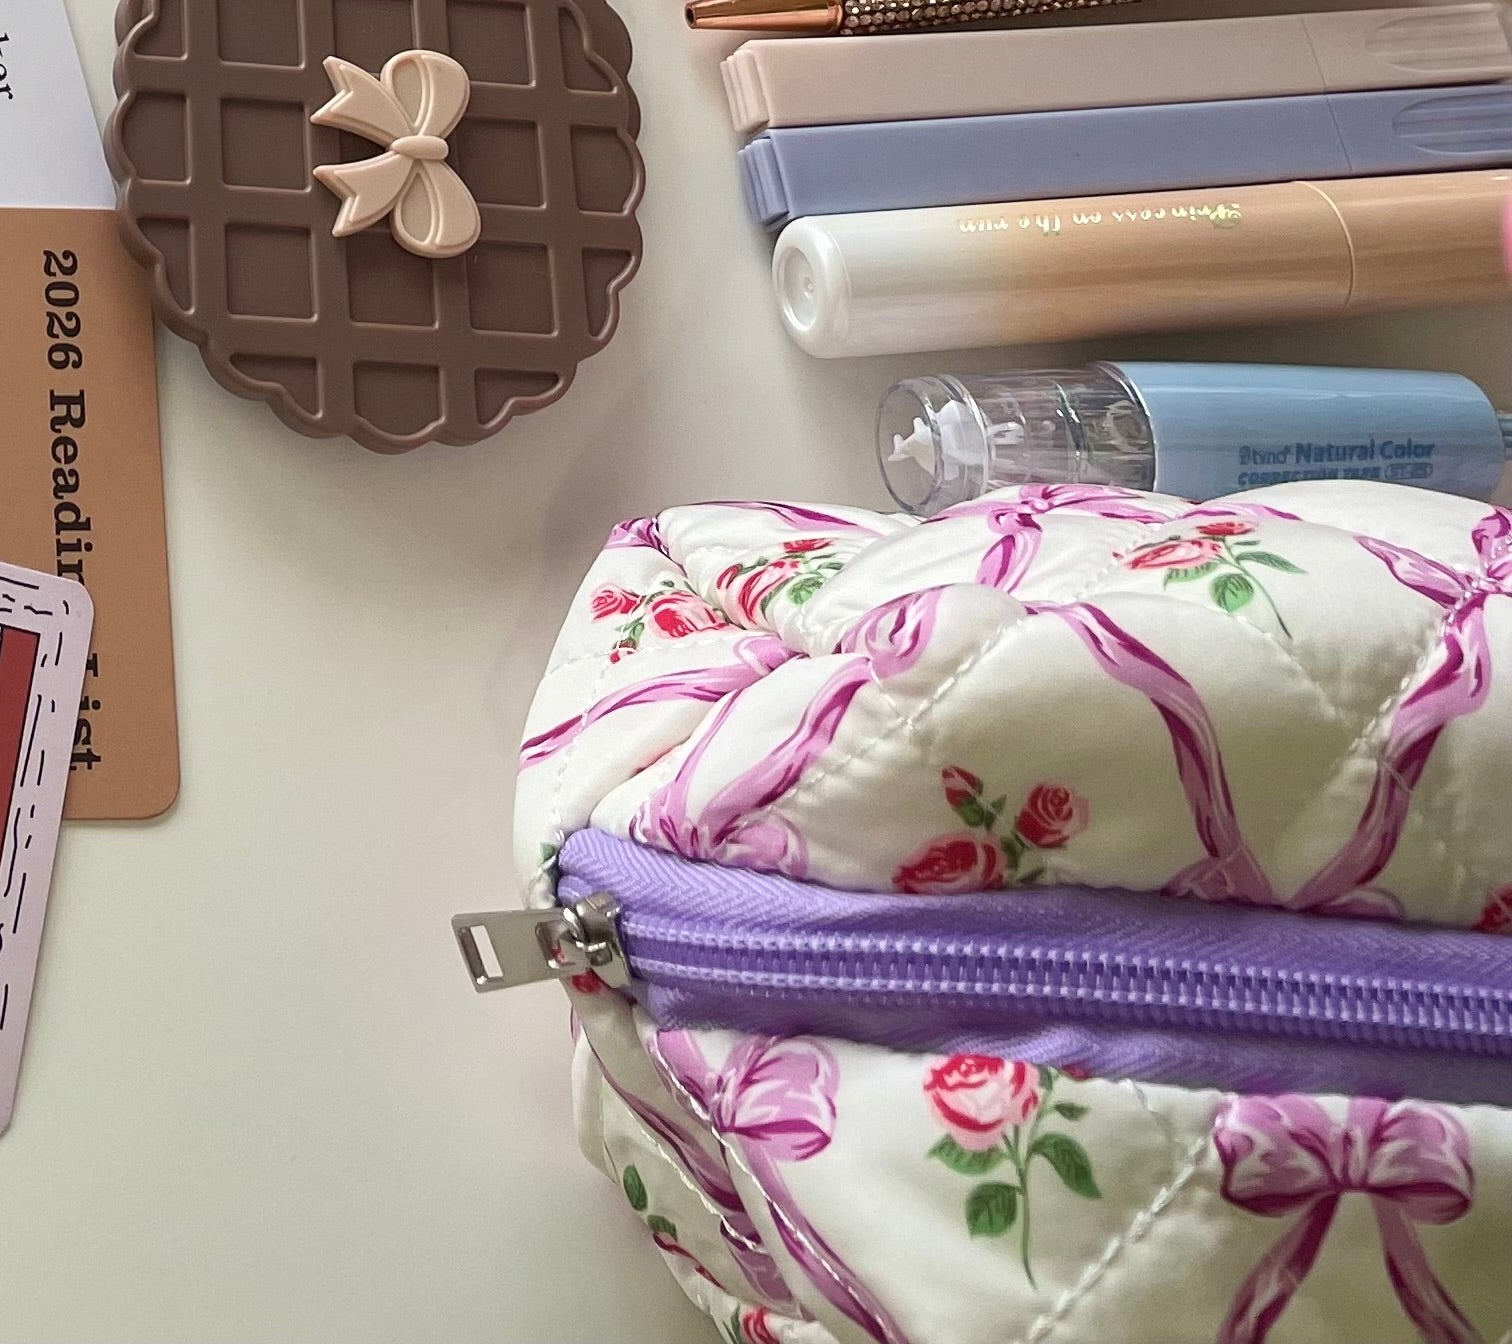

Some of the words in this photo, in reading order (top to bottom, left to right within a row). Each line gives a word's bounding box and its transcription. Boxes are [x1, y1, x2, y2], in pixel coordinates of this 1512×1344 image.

[42, 248, 83, 371] 2026
[49, 389, 93, 589] Readin
[1295, 438, 1375, 464] Natural
[1380, 437, 1436, 460] Color
[68, 653, 102, 771] ist
